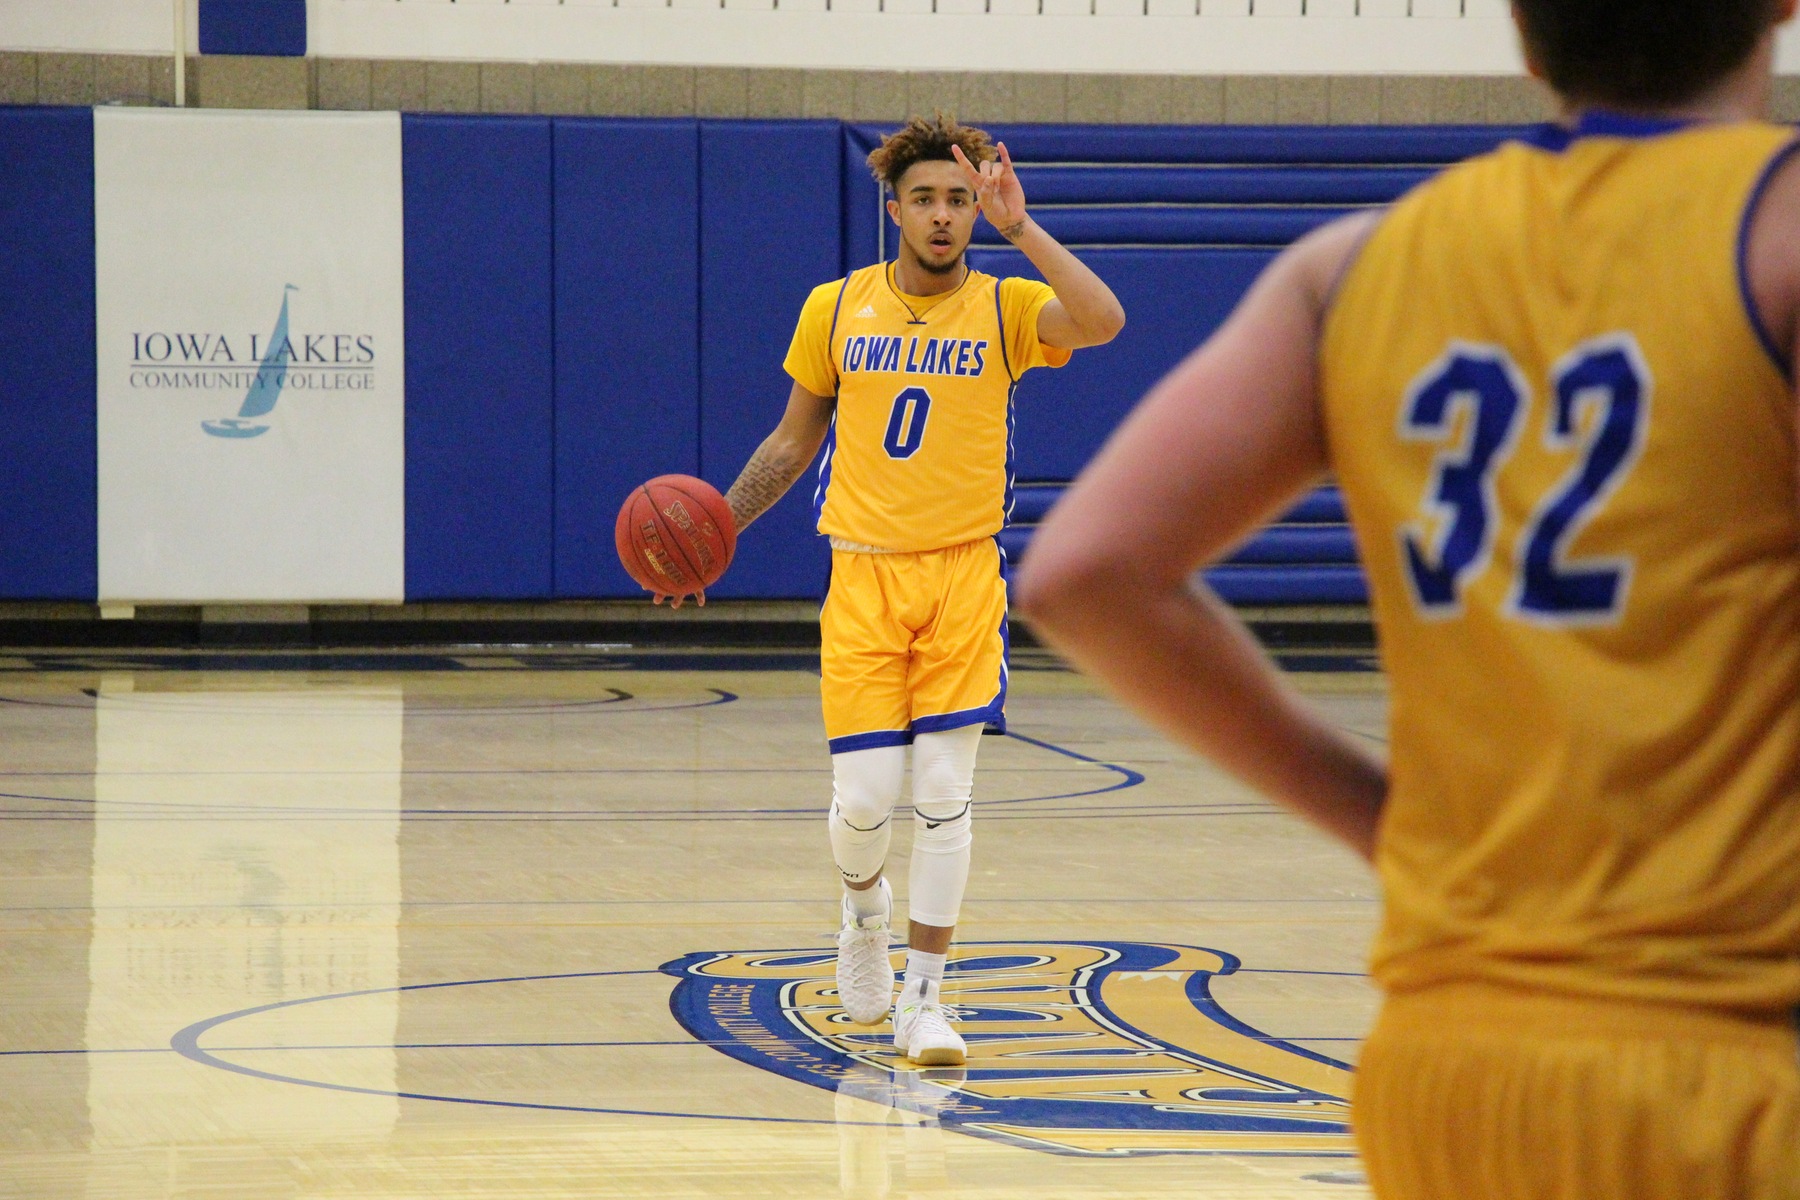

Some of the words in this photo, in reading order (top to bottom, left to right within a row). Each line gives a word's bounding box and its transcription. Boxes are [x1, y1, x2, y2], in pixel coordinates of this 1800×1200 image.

[132, 332, 235, 362] IOWA
[249, 333, 375, 364] LAKES
[843, 335, 902, 373] IOWA
[904, 337, 989, 377] LAKES
[130, 371, 267, 390] COMMUNITY
[276, 372, 375, 391] COLLEGE
[882, 385, 932, 461] 0
[1396, 331, 1654, 628] 32
[707, 984, 756, 1016] COLLEGE
[714, 1017, 823, 1062] COMMUNITY
